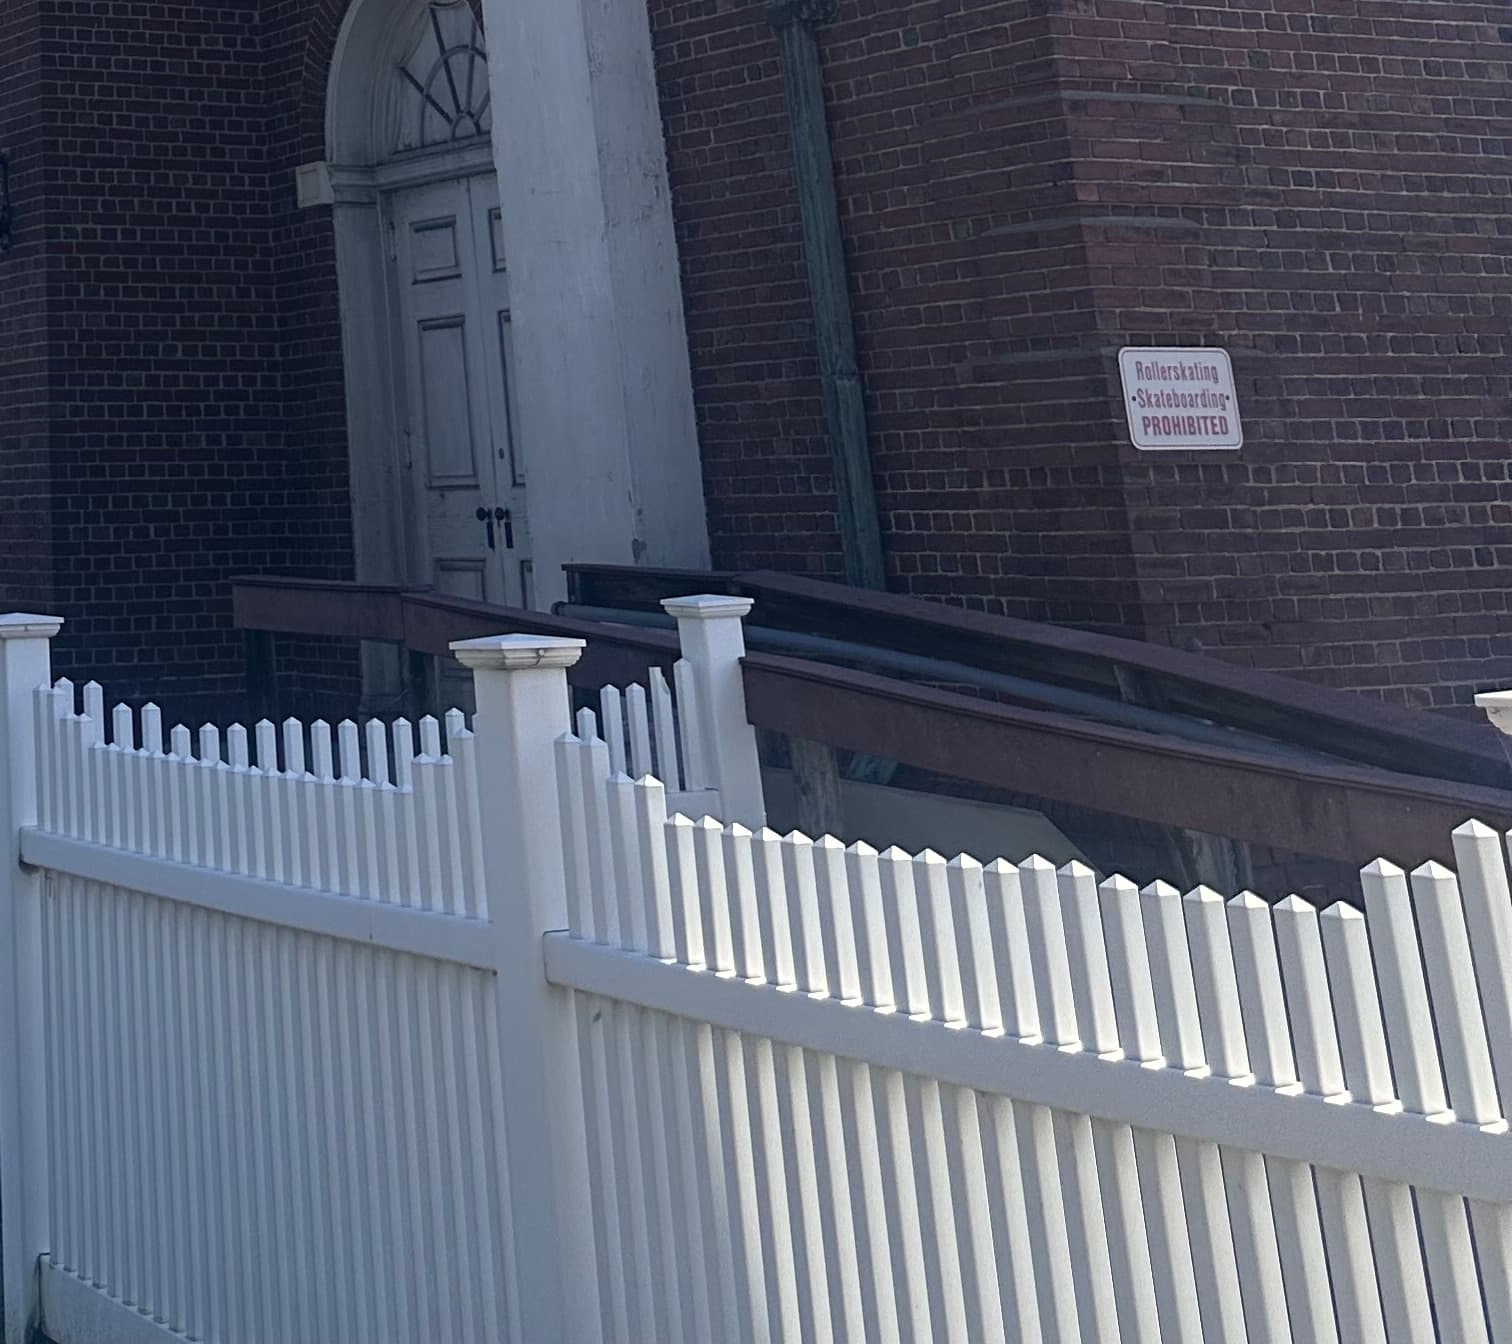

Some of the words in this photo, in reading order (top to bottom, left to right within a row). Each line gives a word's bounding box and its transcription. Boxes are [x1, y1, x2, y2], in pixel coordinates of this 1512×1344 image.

[1135, 360, 1219, 384] Rollerskating
[1136, 388, 1227, 411] Skateboarding
[1142, 415, 1229, 437] PROHIBITED
